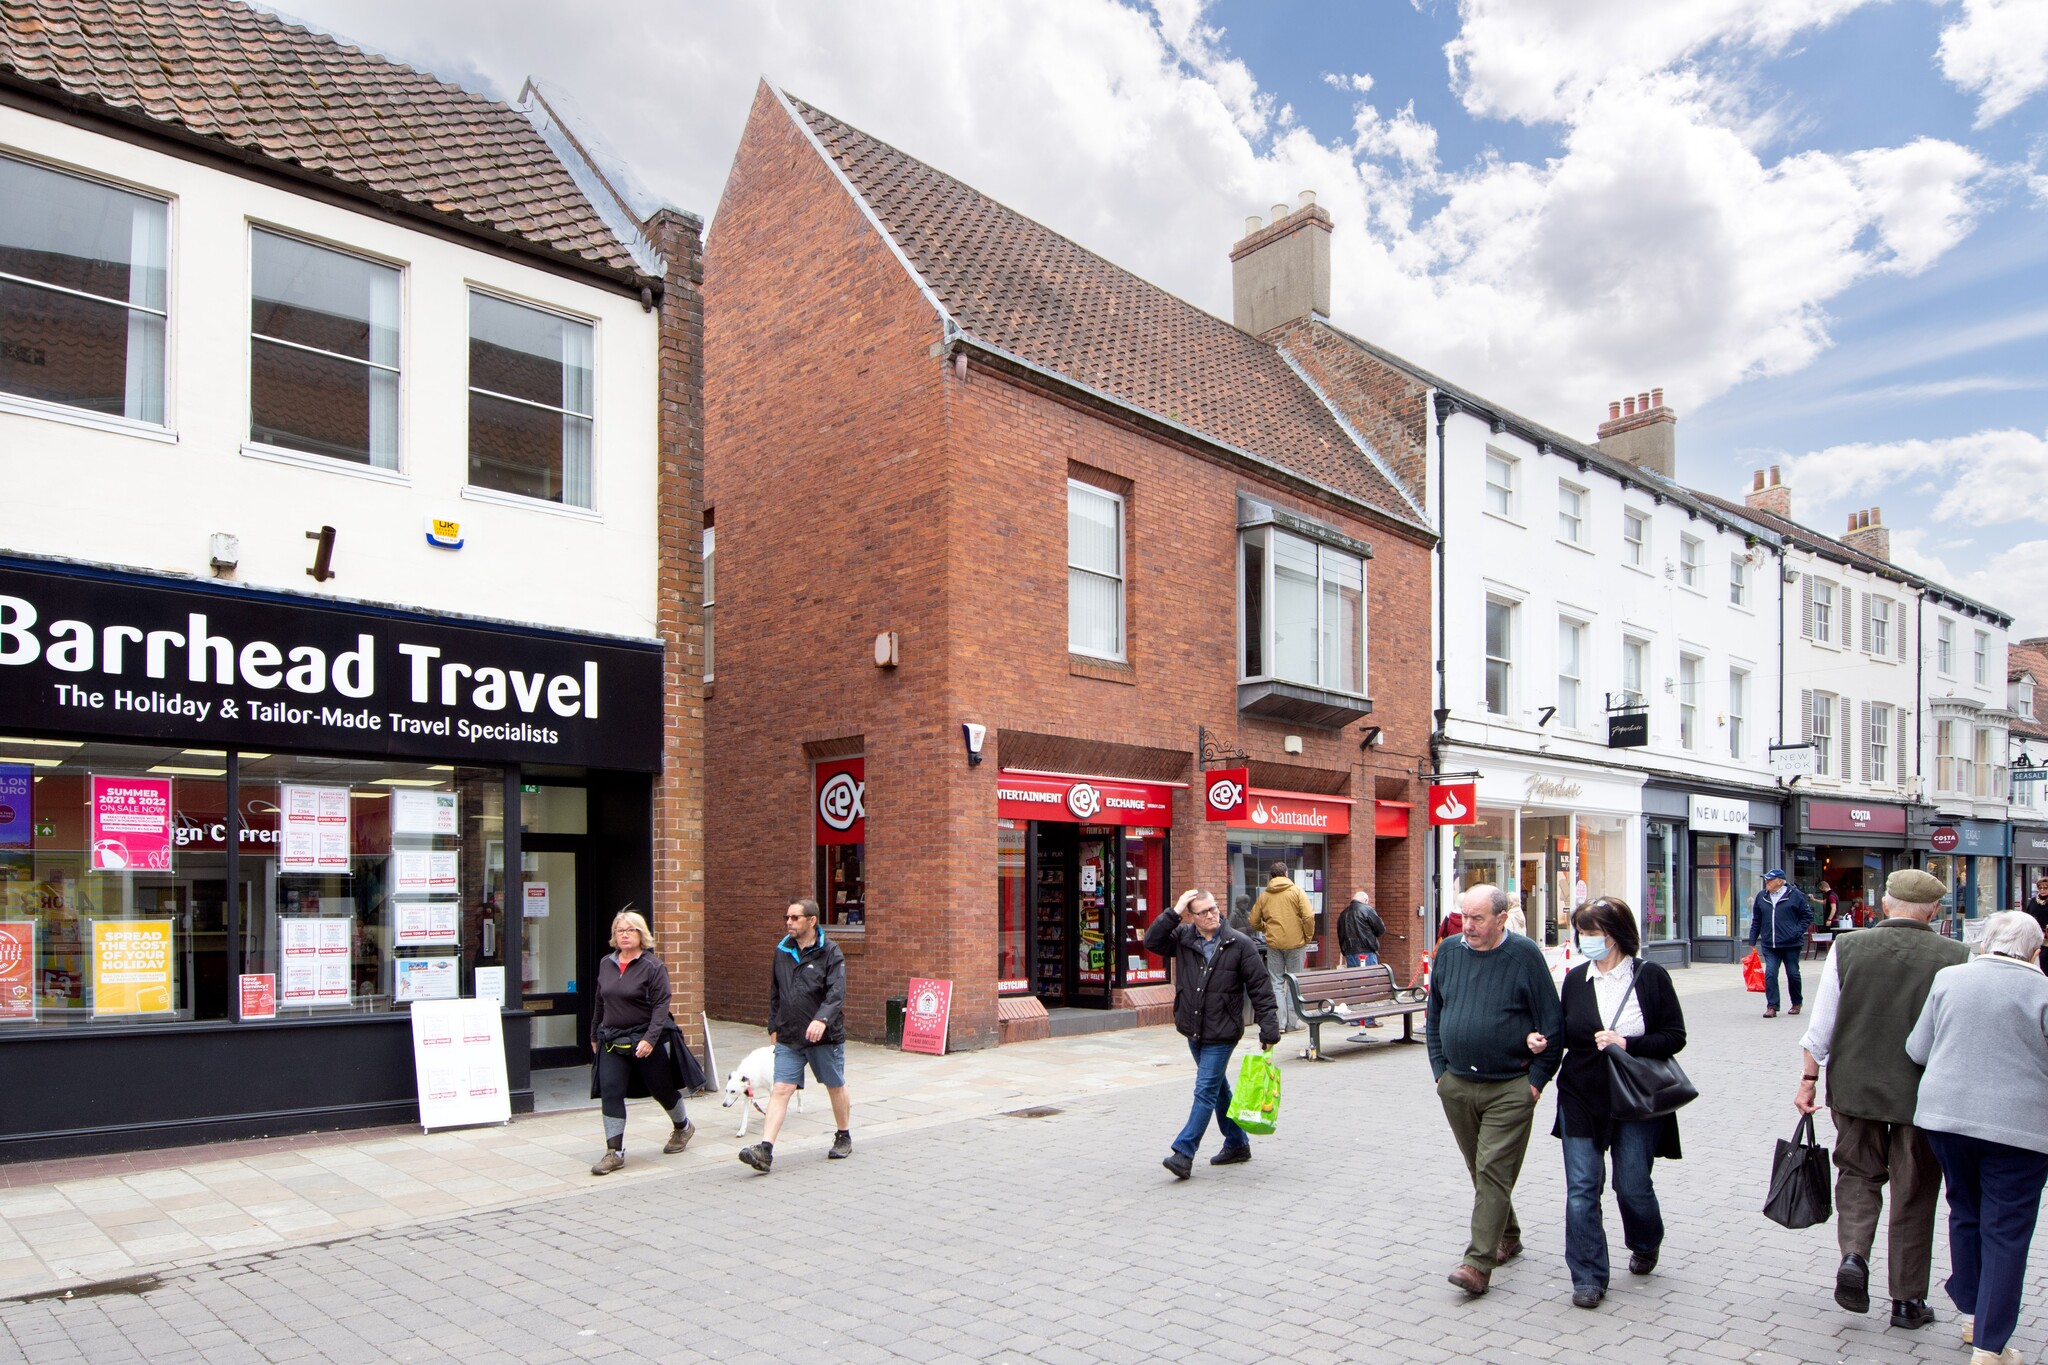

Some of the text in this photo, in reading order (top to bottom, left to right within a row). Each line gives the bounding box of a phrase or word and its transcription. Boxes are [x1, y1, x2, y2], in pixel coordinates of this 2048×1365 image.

[439, 520, 454, 530] UK
[0, 594, 598, 719] Barrhead Travel
[54, 684, 558, 744] The Holiday & Tailor-Made Travel Specialists
[1780, 753, 1808, 761] NEW
[1778, 762, 1810, 770] LOOK
[8, 778, 27, 786] ON
[107, 788, 158, 798] SUMMER
[99, 796, 166, 806] 2021 & 2022
[998, 788, 1062, 804] NTERTAINMENT
[1106, 797, 1146, 810] EXCHANGE
[1270, 805, 1328, 827] Santander
[1696, 806, 1748, 824] NEW LOOK
[1851, 809, 1871, 821] COSTA
[105, 932, 162, 941] SPREAD
[100, 941, 168, 950] THE COST
[102, 951, 165, 960] OF YOUR
[102, 960, 165, 970] HOLIDAY
[1126, 972, 1136, 980] BUY
[1137, 971, 1148, 980] SELL
[998, 980, 1027, 991] RECYCLING
